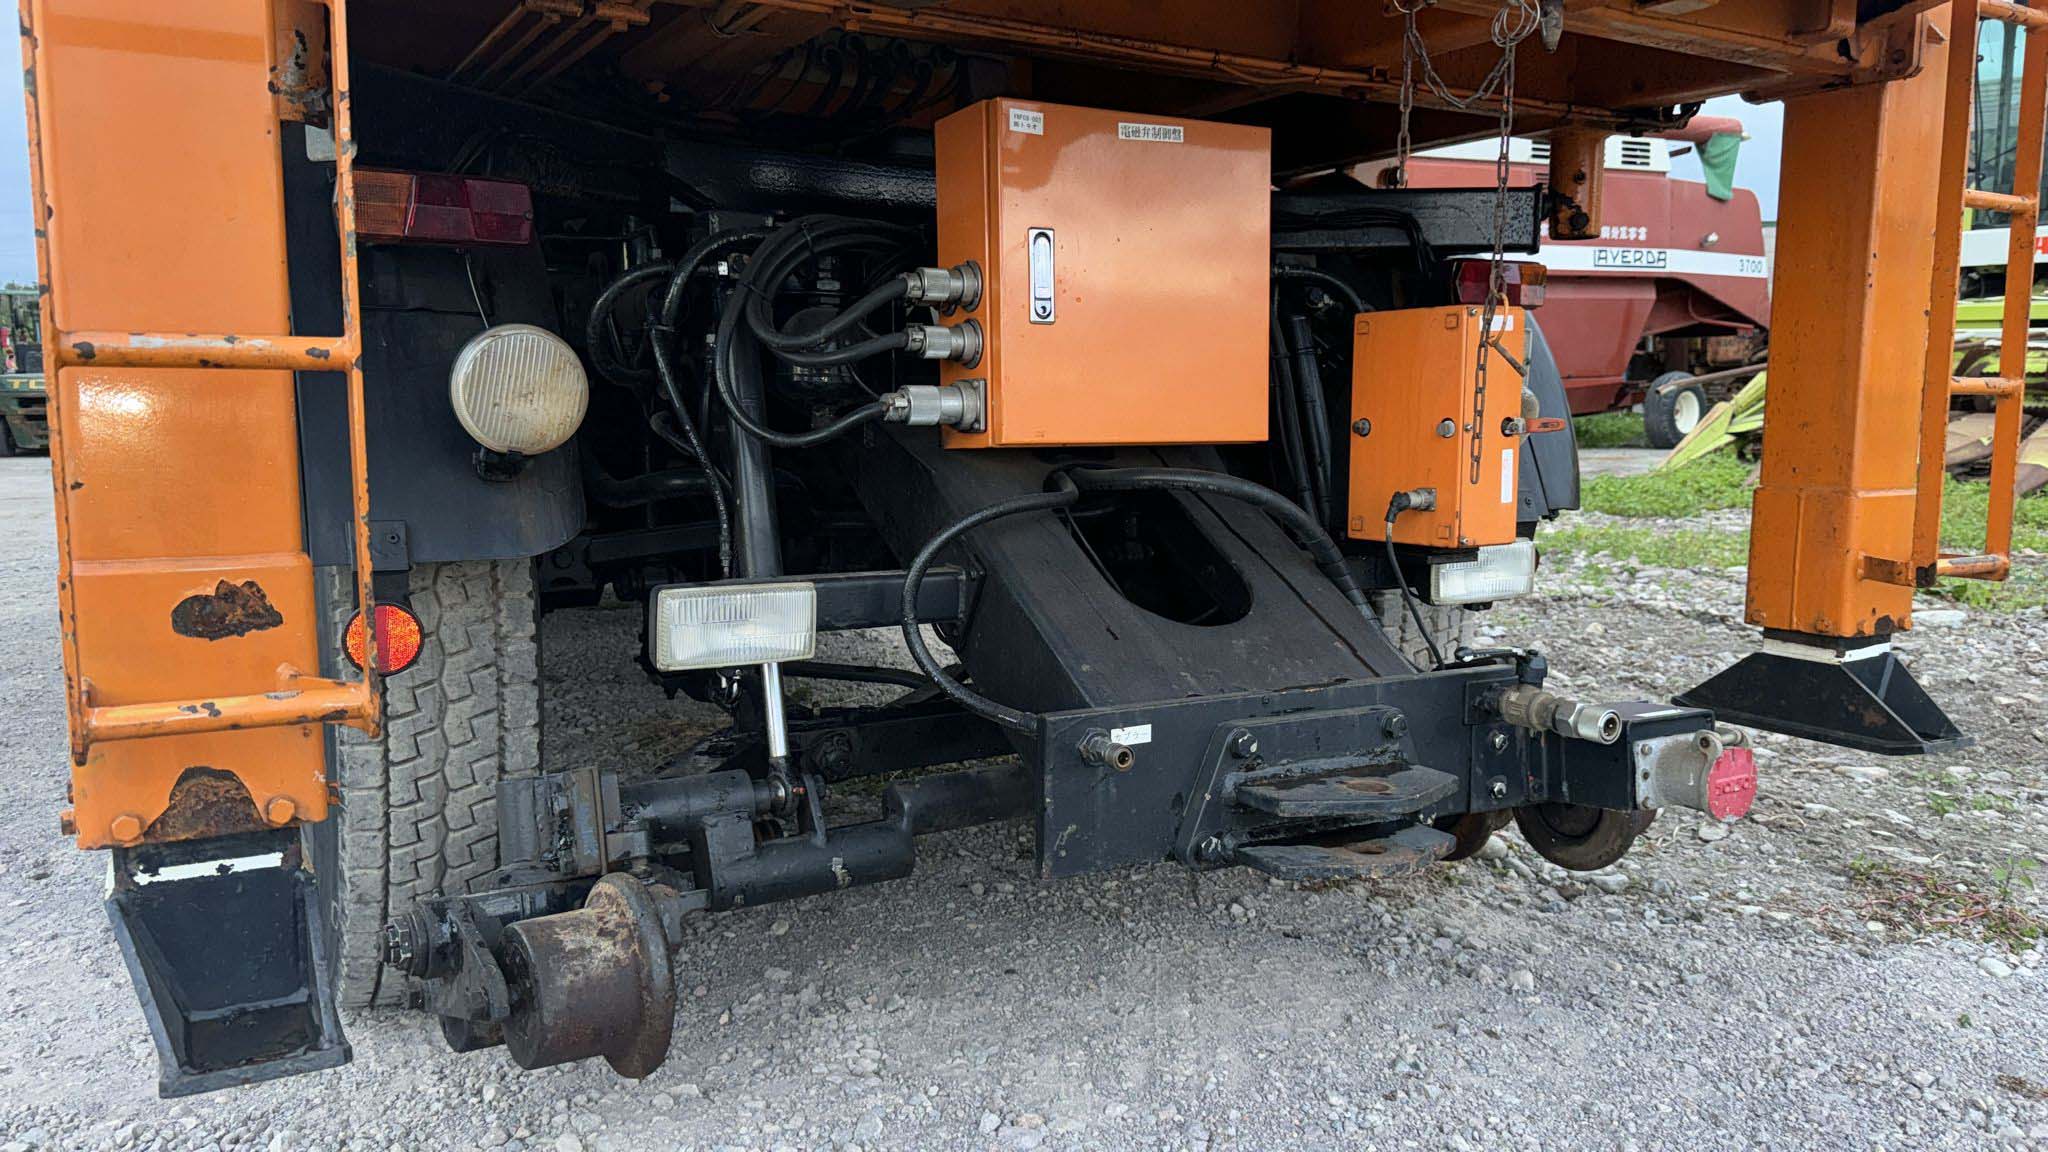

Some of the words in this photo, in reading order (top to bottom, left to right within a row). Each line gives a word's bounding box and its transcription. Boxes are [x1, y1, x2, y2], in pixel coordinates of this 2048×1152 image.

[1120, 125, 1182, 141] 電磁弁制御盤
[1738, 258, 1763, 274] 3700
